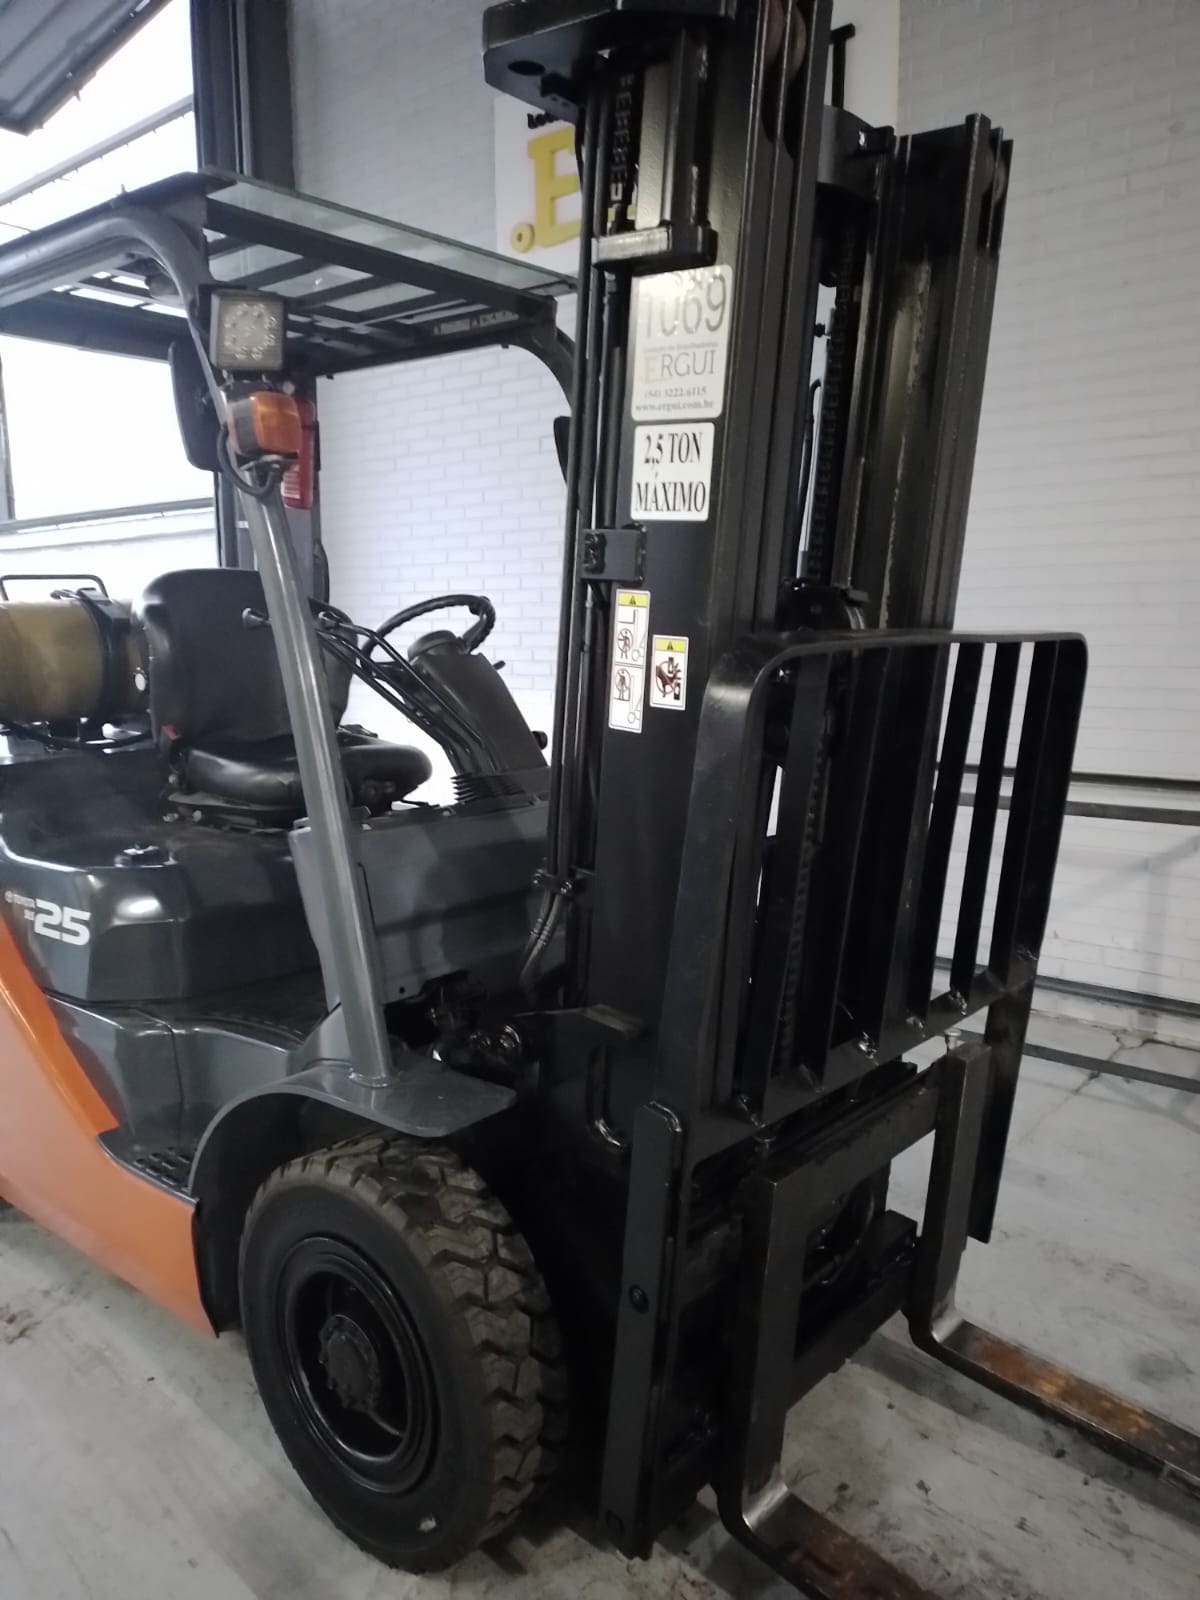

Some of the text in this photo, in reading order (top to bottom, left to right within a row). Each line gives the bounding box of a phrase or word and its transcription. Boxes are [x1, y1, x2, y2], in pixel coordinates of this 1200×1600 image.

[643, 349, 717, 384] ERGUI
[668, 431, 702, 464] TON
[634, 471, 706, 513] MÁXIMO
[34, 898, 91, 946] 25
